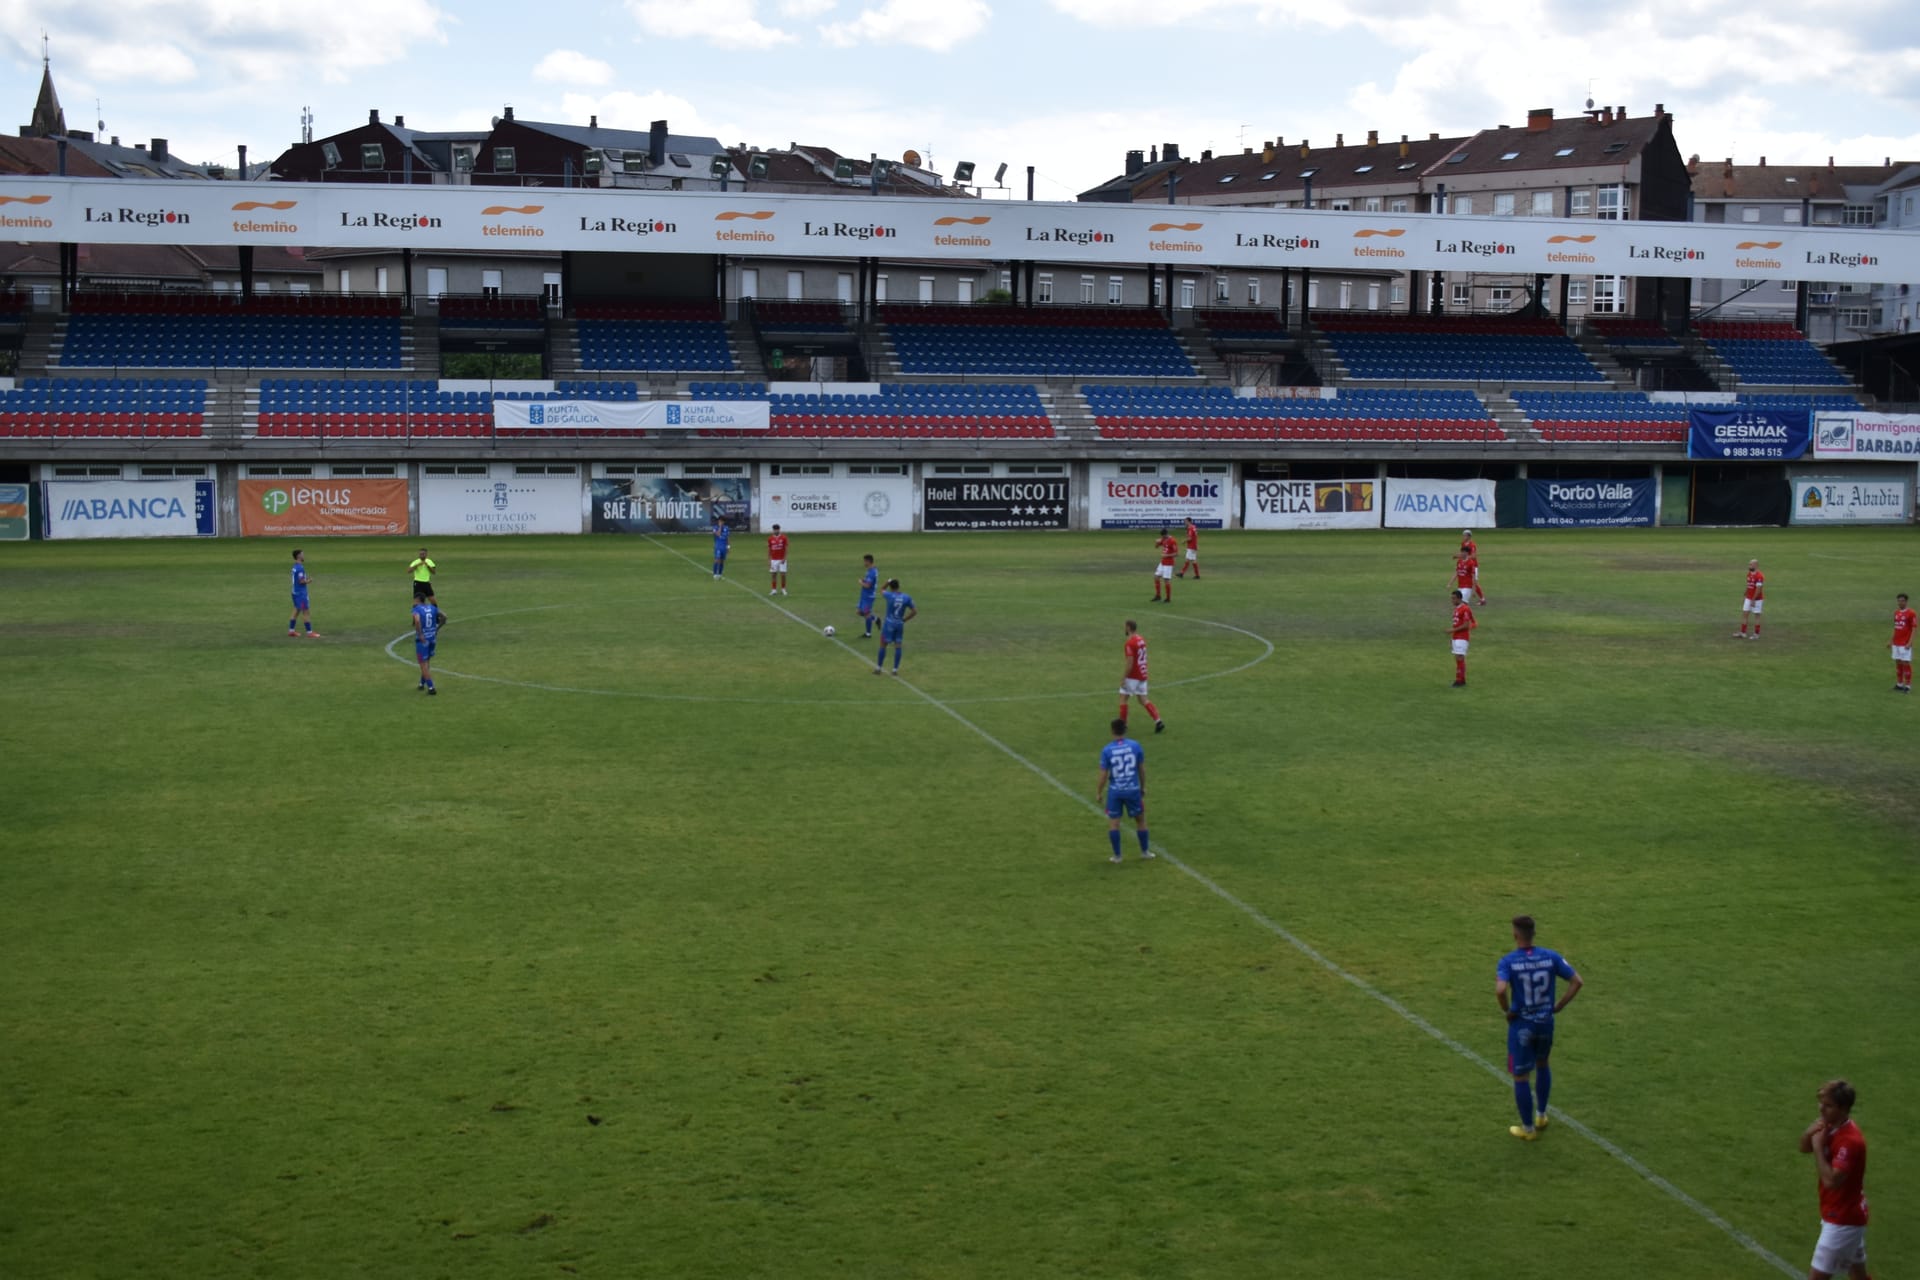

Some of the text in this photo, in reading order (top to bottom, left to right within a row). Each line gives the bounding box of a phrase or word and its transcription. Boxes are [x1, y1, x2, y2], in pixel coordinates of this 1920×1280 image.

[85, 208, 190, 226] La Región
[341, 212, 442, 231] La Región
[233, 220, 298, 233] telemiño
[482, 224, 544, 237] telemiño
[580, 217, 677, 236] La Región
[804, 222, 896, 240] La Región
[716, 230, 775, 242] telemiño
[934, 235, 991, 247] telemiño
[1026, 227, 1114, 245] La Región
[1236, 233, 1320, 251] La Región
[1149, 240, 1203, 252] telemiño
[1353, 246, 1405, 258] telemiño
[1436, 239, 1515, 257] La Región
[1547, 252, 1596, 263] telemiño
[1629, 245, 1705, 262] La Región
[1806, 251, 1878, 268] La Región
[1735, 258, 1781, 269] telemiño
[547, 405, 579, 414] XUNTA
[683, 405, 715, 414] XUNTA
[547, 415, 600, 423] DE GALICIA
[683, 415, 735, 423] DE GALICIA
[1714, 425, 1788, 437] GESMAK
[1733, 448, 1782, 456] 988 384 515
[927, 484, 1065, 501] Hotel FRANCISCO II
[1257, 482, 1312, 498] PONTE
[1549, 483, 1632, 500] Porto Valla
[791, 494, 820, 502] Concello
[320, 506, 388, 516] supermercados
[604, 498, 703, 519] SAE AÍ E MÓVETE
[791, 502, 838, 511] OURENSE
[1257, 499, 1312, 513] VELLA
[466, 512, 537, 522] DEPUTACIÓN
[476, 523, 528, 532] OURENSE
[935, 519, 1059, 528] www.ga-hoteles.es
[1110, 753, 1136, 778] 22
[1518, 971, 1550, 1005] 12
